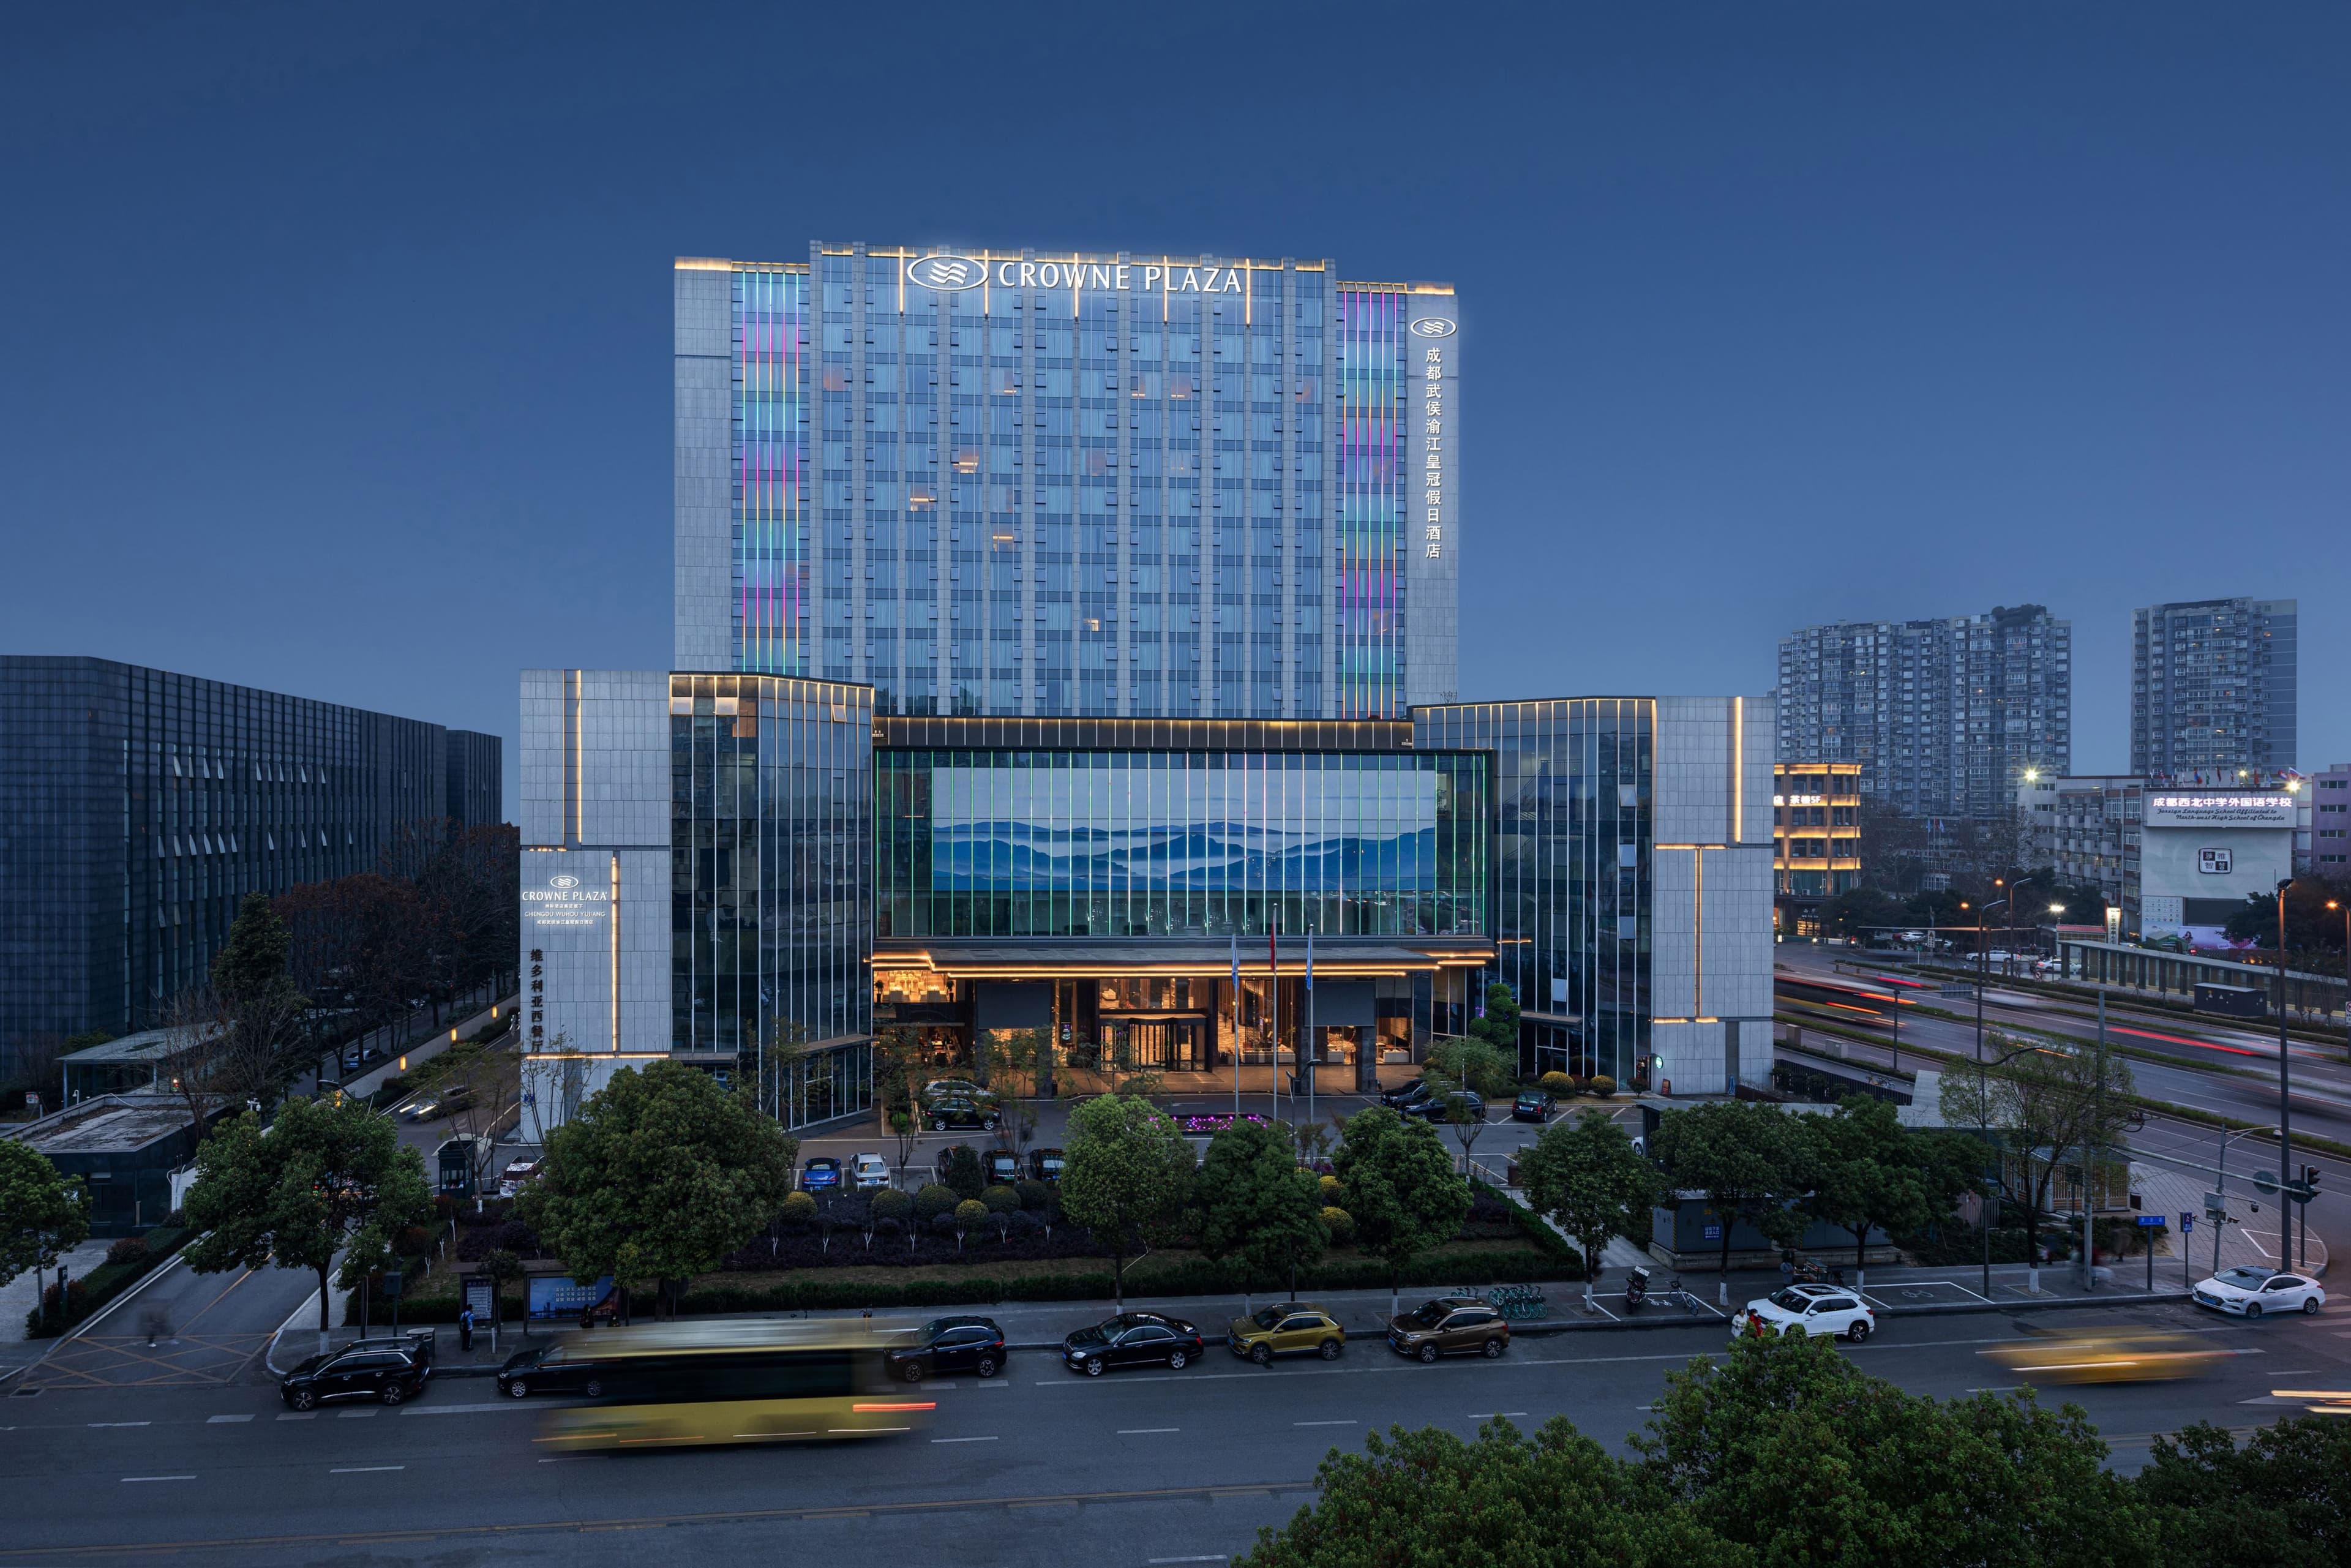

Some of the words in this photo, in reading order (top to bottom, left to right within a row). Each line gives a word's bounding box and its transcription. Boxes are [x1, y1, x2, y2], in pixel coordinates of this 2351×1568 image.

[999, 262, 1130, 290] CROWNE
[1146, 266, 1243, 293] PLAZA
[1425, 347, 1442, 558] 成都武侯渝江皇冠假日酒店
[2153, 797, 2293, 807] 成都西北中学外国语学校
[522, 891, 568, 901] CROWNE
[572, 891, 607, 901] PLAZA
[530, 949, 544, 1052] 维多利亚西餐厅
